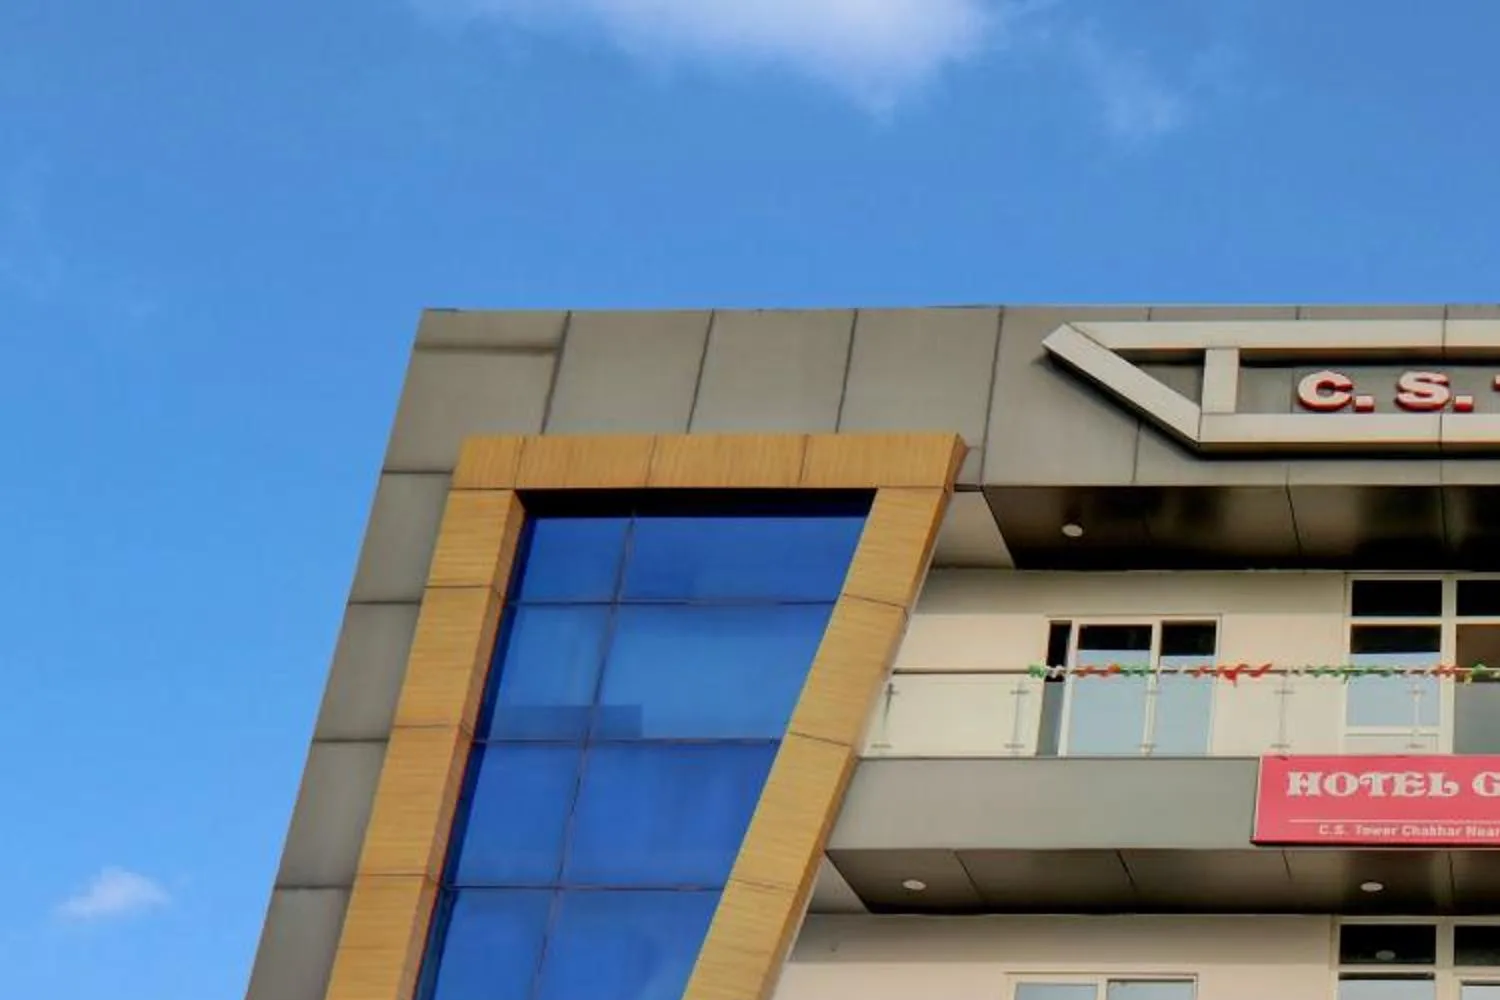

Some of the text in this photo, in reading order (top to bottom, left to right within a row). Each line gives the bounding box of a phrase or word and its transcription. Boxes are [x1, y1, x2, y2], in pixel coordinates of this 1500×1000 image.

[1296, 372, 1374, 412] C.
[1396, 372, 1474, 412] S.
[1286, 771, 1459, 799] HOTEL
[1355, 825, 1397, 836] Tower
